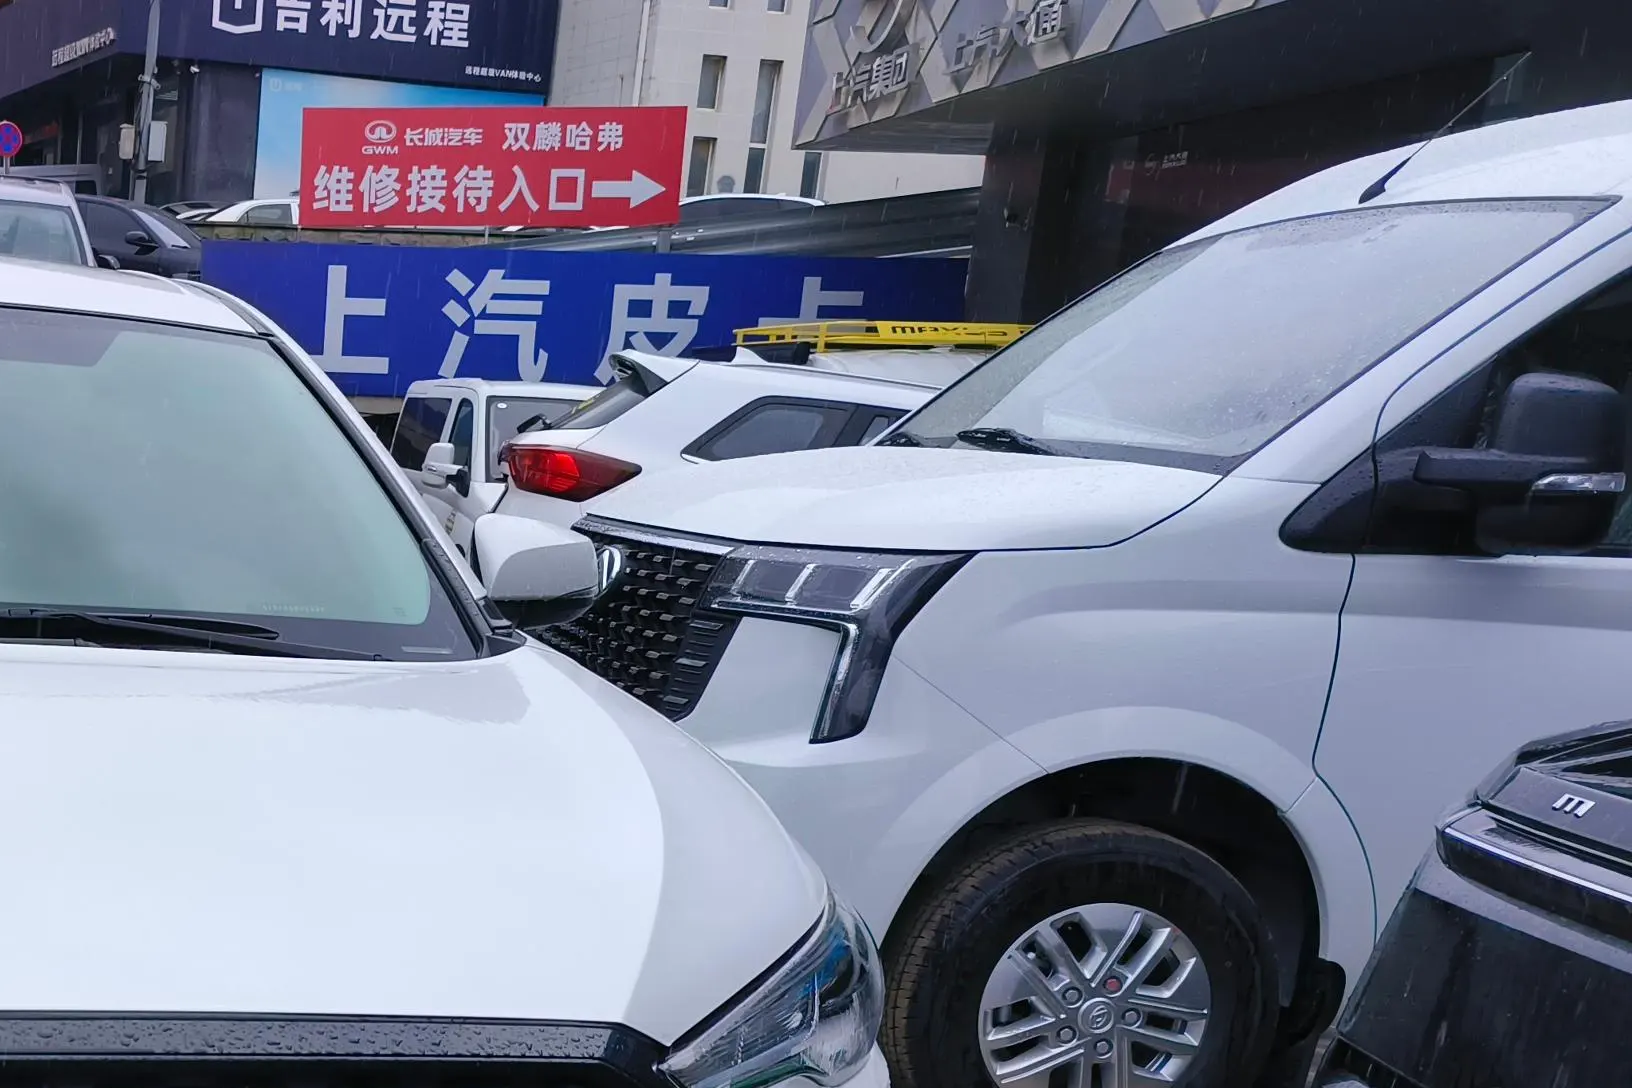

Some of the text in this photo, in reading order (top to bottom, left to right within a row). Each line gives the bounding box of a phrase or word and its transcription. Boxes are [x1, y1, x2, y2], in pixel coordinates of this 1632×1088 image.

[276, 0, 470, 48] 吉利远程
[361, 145, 399, 155] GWM
[403, 121, 624, 153] 长城汽车 双麟哈弗
[312, 164, 586, 214] 维修接待入口
